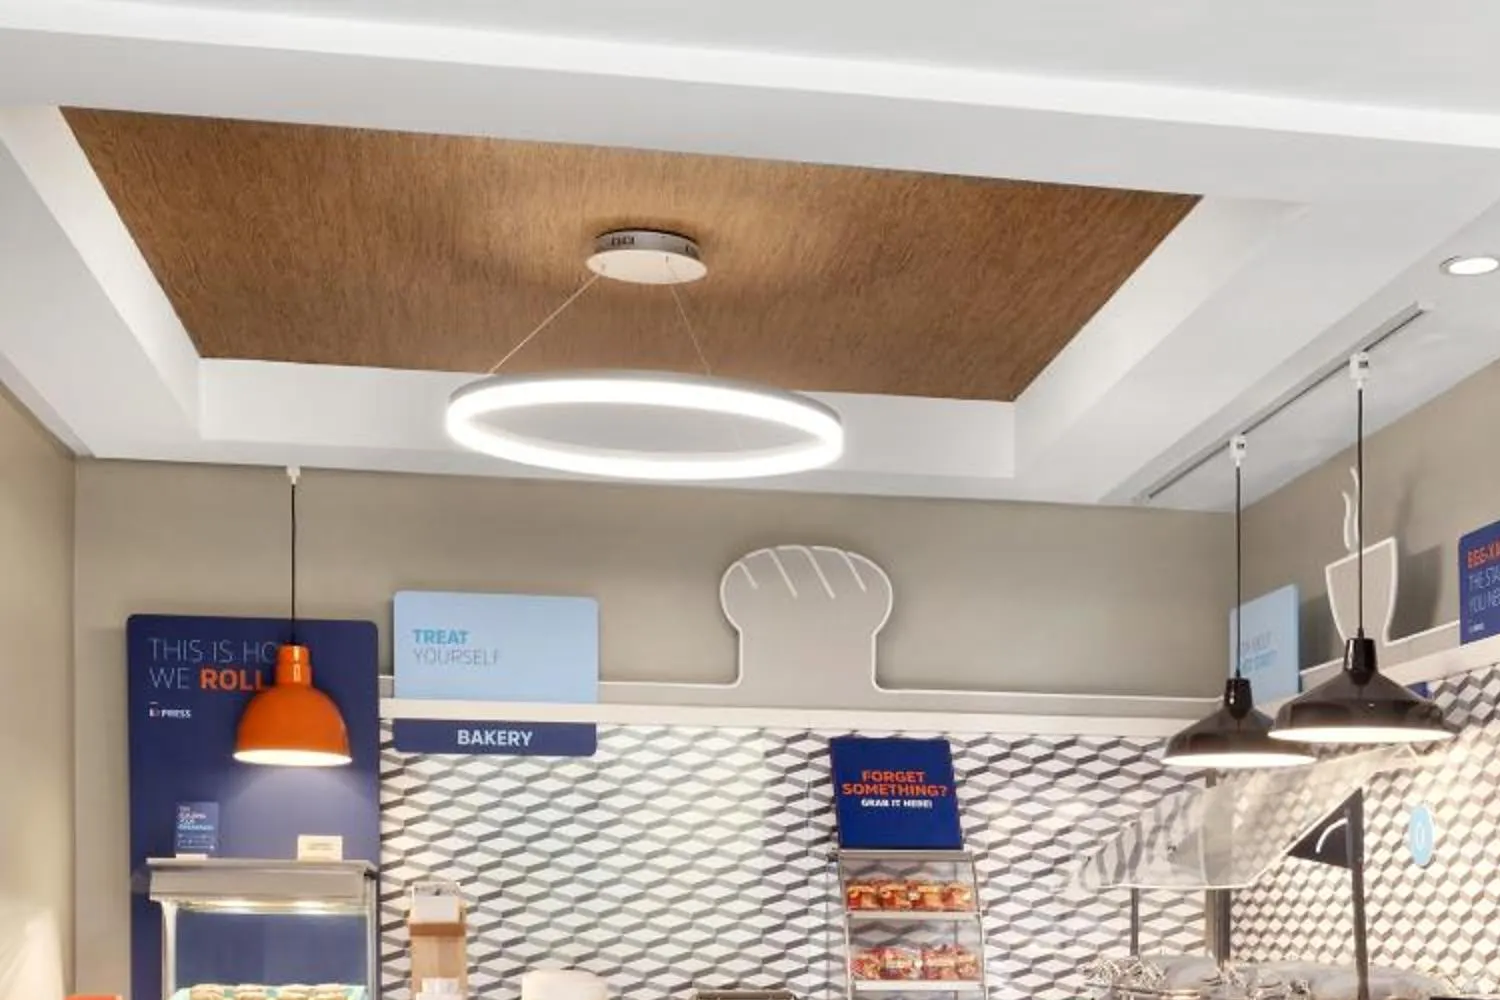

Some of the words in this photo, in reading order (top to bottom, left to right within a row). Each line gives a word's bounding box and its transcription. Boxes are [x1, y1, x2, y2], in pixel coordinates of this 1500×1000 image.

[412, 628, 469, 645] TREAT
[149, 638, 203, 663] THIS
[213, 640, 234, 663] IS
[243, 640, 278, 664] HO
[413, 647, 500, 667] YOURSELF
[149, 667, 191, 690] WE
[457, 729, 533, 747] BAKERY
[862, 770, 926, 783] FORGET
[842, 783, 948, 797] SOMETHING?
